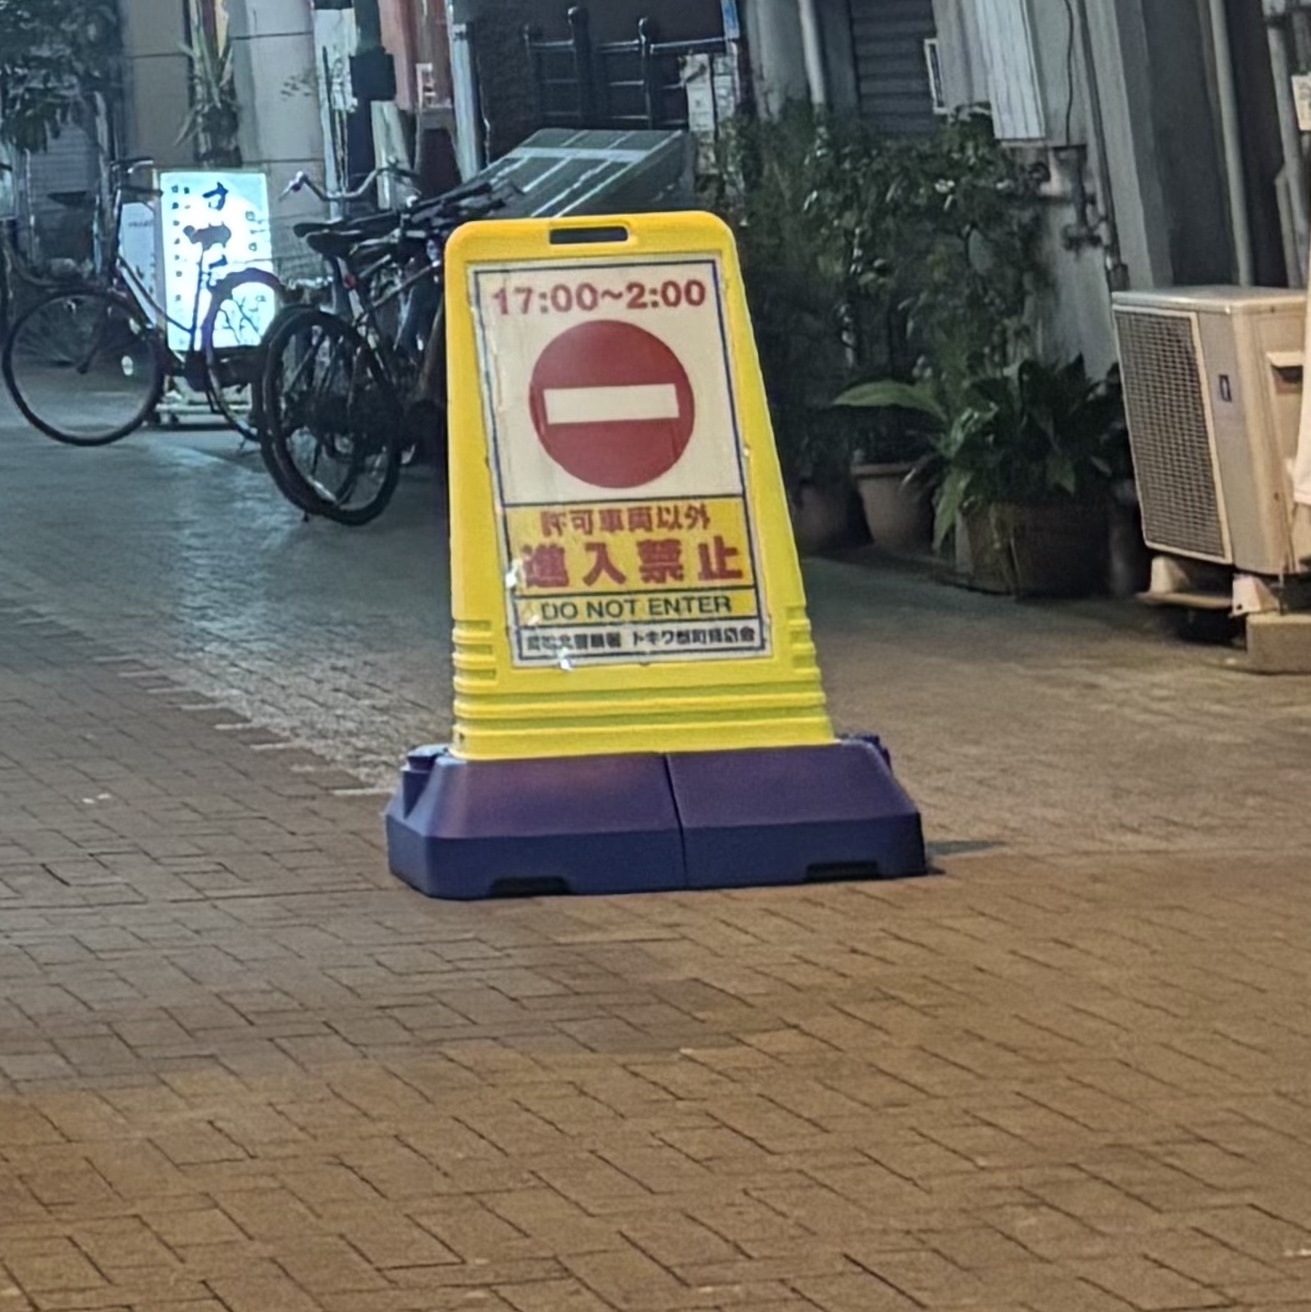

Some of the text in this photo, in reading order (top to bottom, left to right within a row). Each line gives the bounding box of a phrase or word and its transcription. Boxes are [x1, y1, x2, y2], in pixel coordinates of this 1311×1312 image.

[540, 503, 711, 537] 許可車両以外
[520, 535, 745, 588] 進入禁止
[541, 595, 733, 621] DO NOT ENTER
